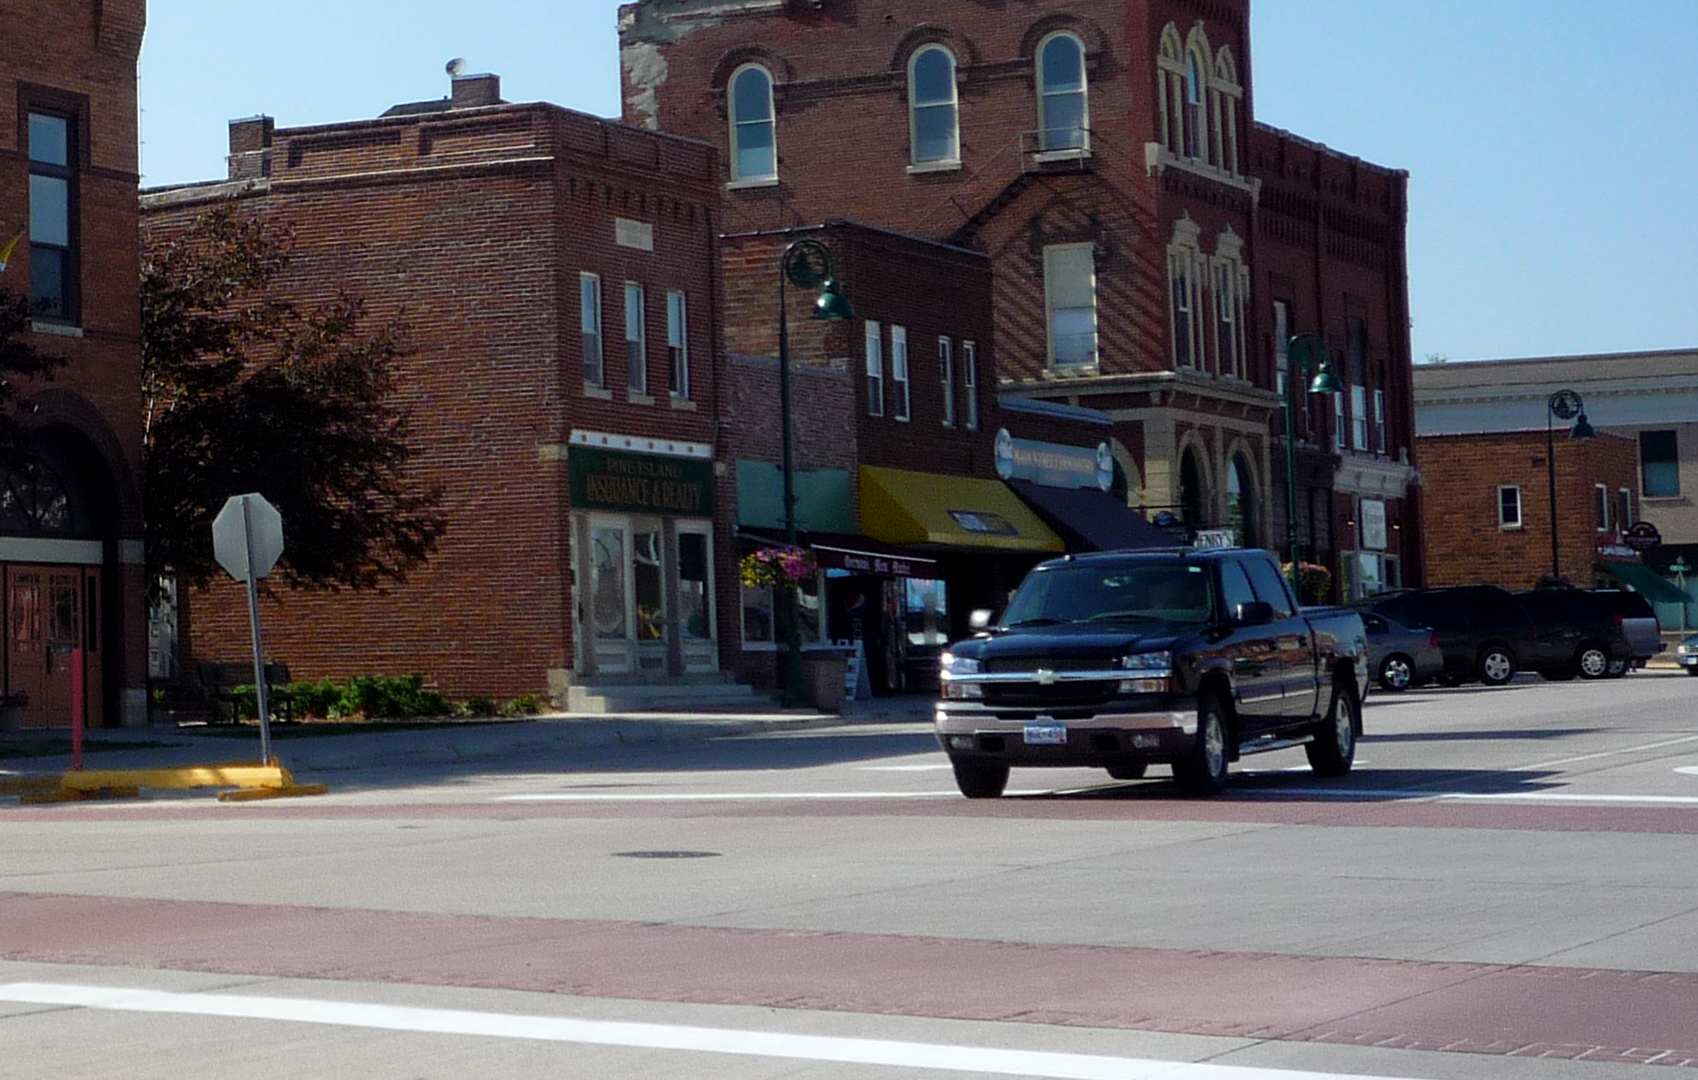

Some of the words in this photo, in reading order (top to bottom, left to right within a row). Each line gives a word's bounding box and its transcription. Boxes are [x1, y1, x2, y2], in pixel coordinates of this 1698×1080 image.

[607, 458, 634, 473] PINE
[638, 462, 679, 478] ISLAND
[587, 474, 648, 505] INSURANCE
[652, 480, 661, 507] &
[663, 481, 700, 511] REALTY
